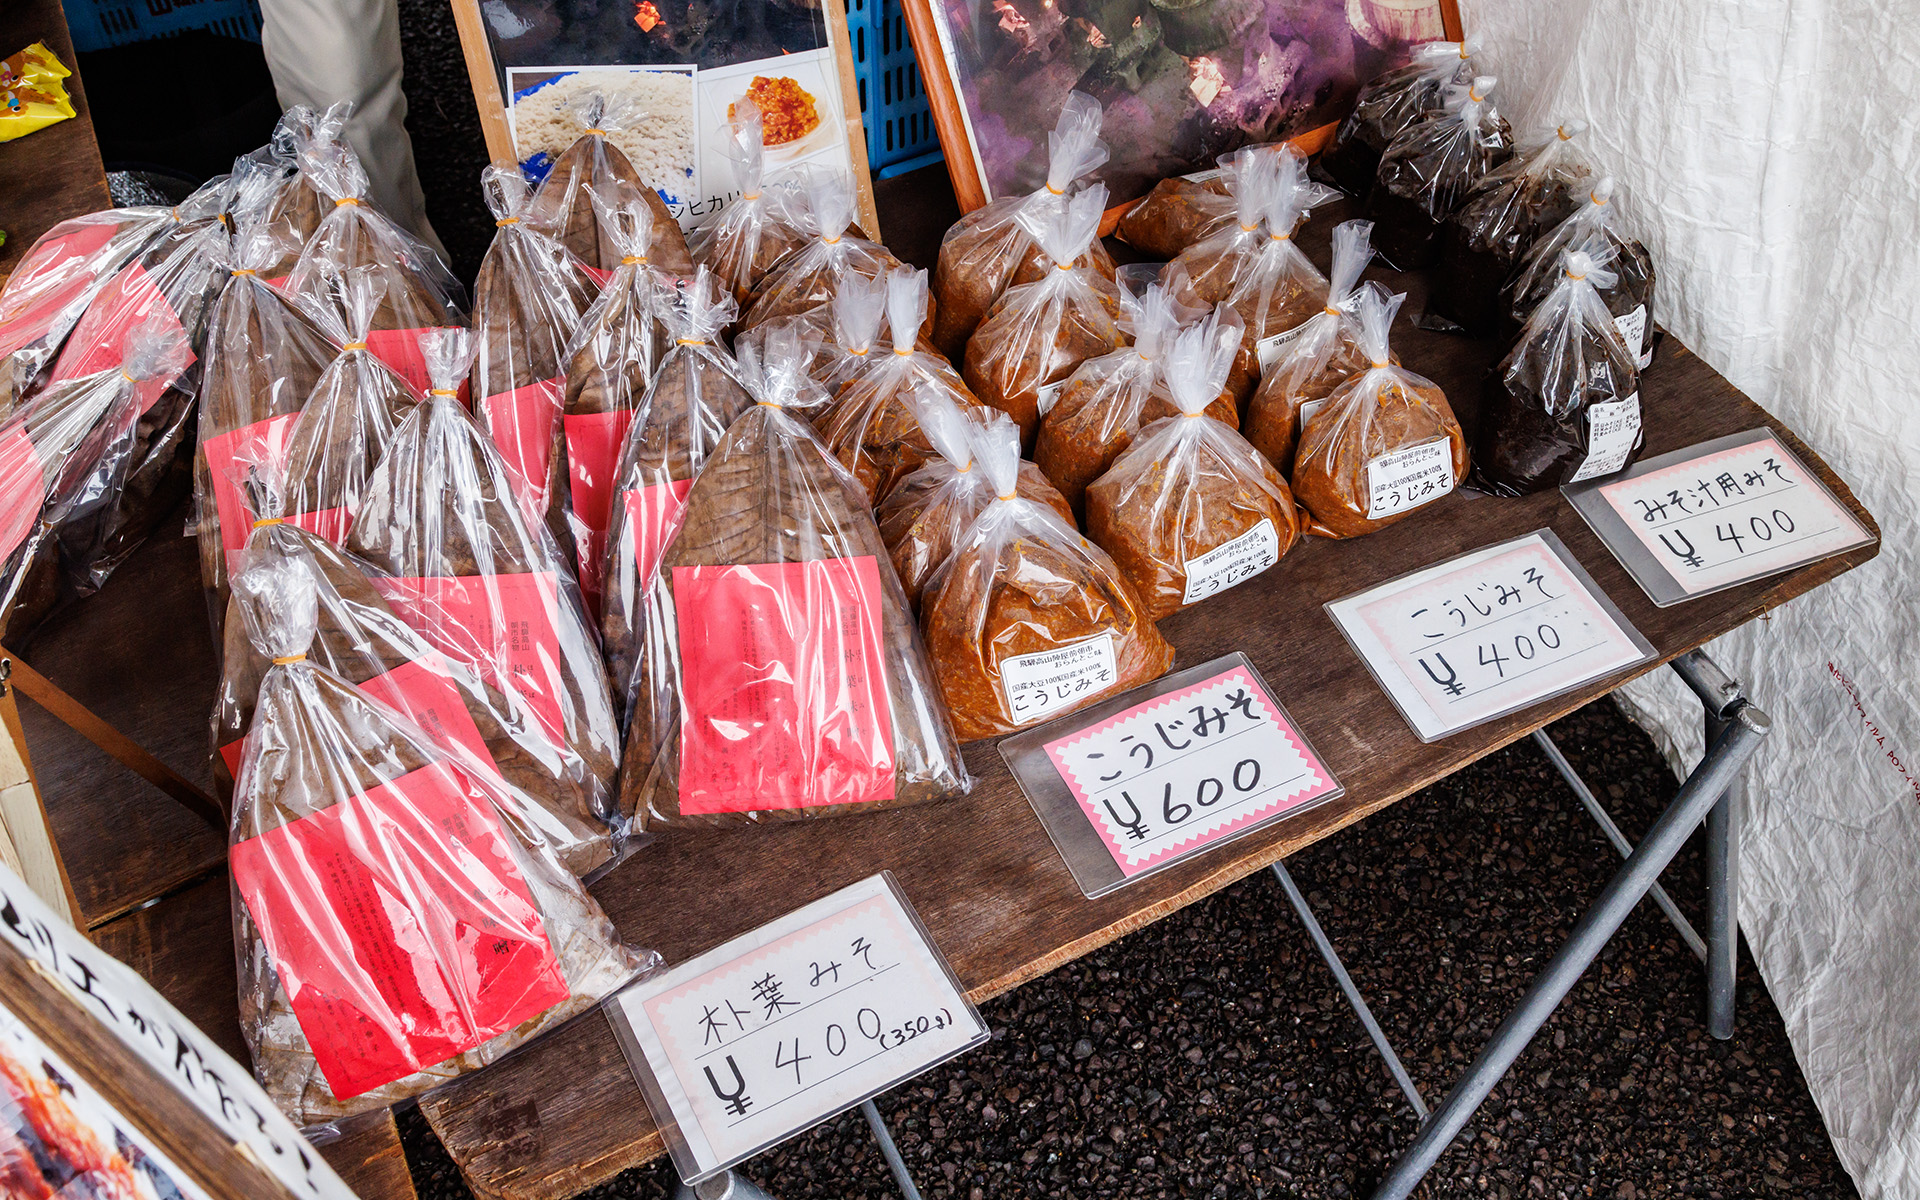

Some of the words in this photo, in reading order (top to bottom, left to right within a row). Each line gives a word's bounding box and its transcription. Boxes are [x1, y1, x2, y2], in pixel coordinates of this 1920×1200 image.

[1375, 473, 1449, 511] こうじみそ
[1634, 458, 1794, 522] みそ汁用みそ
[1189, 554, 1273, 598] こうじみそ
[1411, 567, 1554, 638] こうじみそ
[1054, 649, 1102, 669] おらんとこ味
[1014, 669, 1111, 711] こうじみそ
[1087, 688, 1261, 782] こうじみそ
[698, 936, 877, 1046] 朴葉みそ
